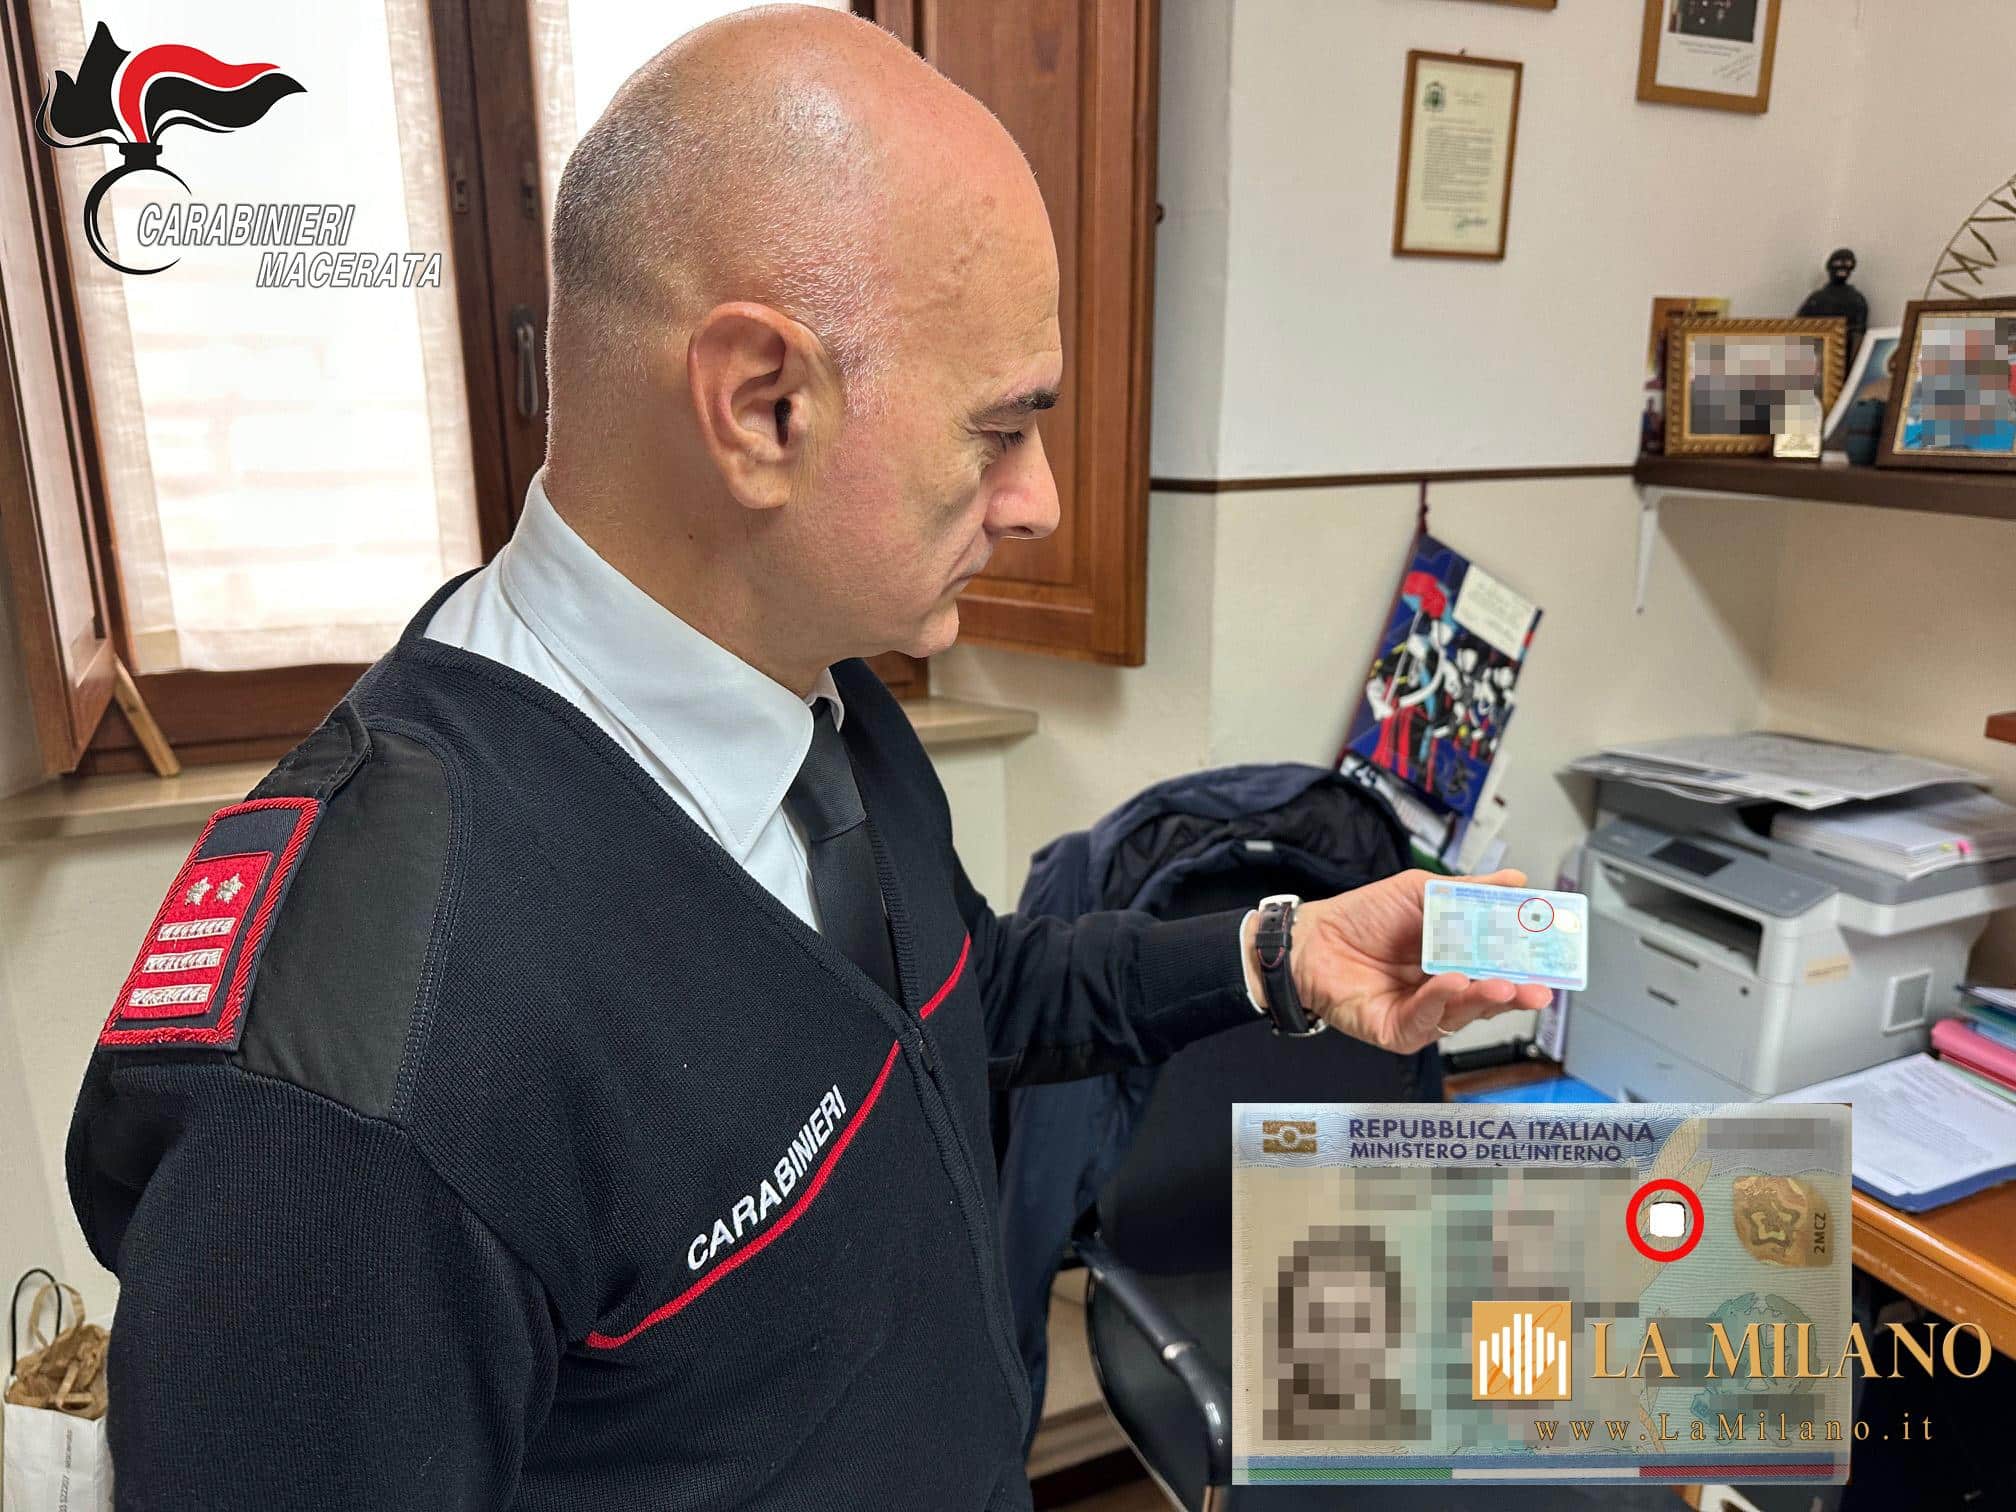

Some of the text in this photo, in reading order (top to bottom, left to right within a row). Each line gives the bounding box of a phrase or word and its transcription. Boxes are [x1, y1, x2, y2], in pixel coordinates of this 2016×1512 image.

[1349, 1118, 1656, 1142] REPUBBLICA ITALIANA
[1350, 1141, 1622, 1162] MINISTERO DELL'INTERNO
[687, 1084, 847, 1271] CARABINIERI
[1814, 1212, 1826, 1256] 2MCZ
